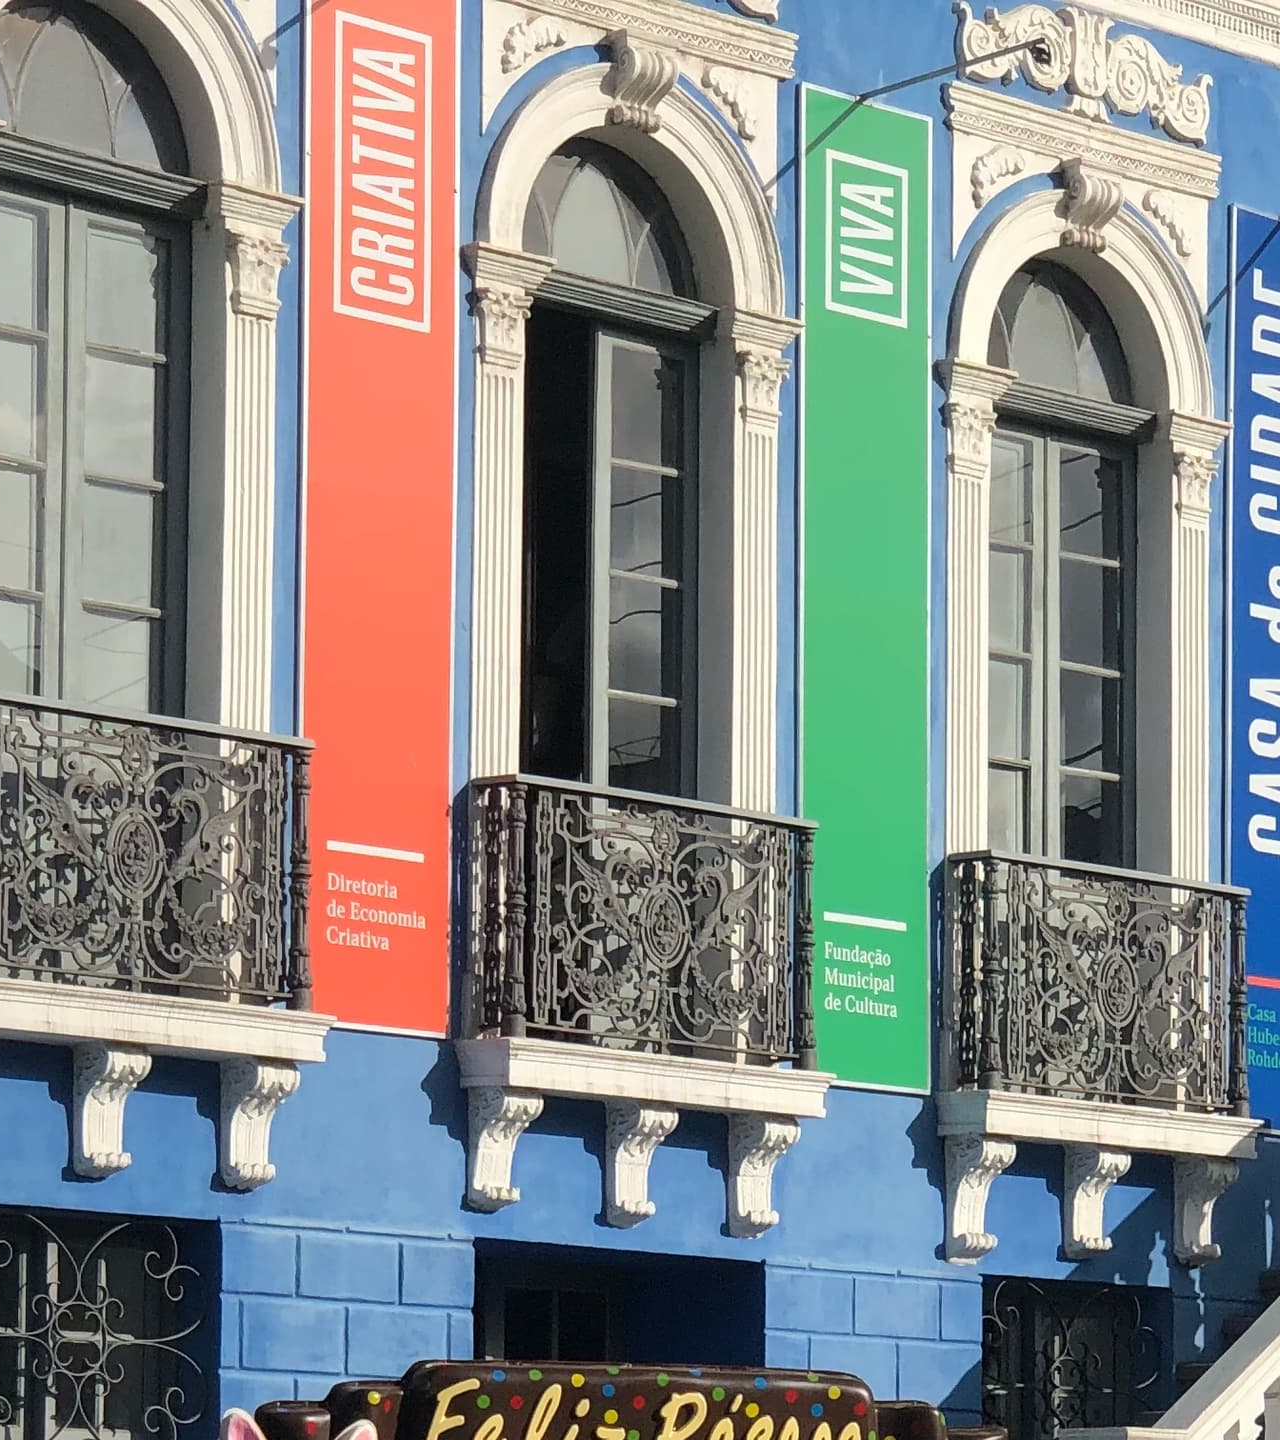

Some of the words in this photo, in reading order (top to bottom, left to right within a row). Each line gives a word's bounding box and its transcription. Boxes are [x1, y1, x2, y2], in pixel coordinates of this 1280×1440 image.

[350, 47, 417, 308] CRIATIVA
[840, 183, 894, 295] VIVA
[327, 872, 398, 899] Diretoria
[326, 899, 346, 919] de
[350, 902, 426, 929] Economia
[326, 926, 390, 950] Criativa
[824, 941, 891, 968] Fundação
[824, 967, 895, 995] Municipal
[824, 992, 841, 1011] de
[844, 995, 898, 1018] Cultura
[1247, 1003, 1276, 1023] Casa
